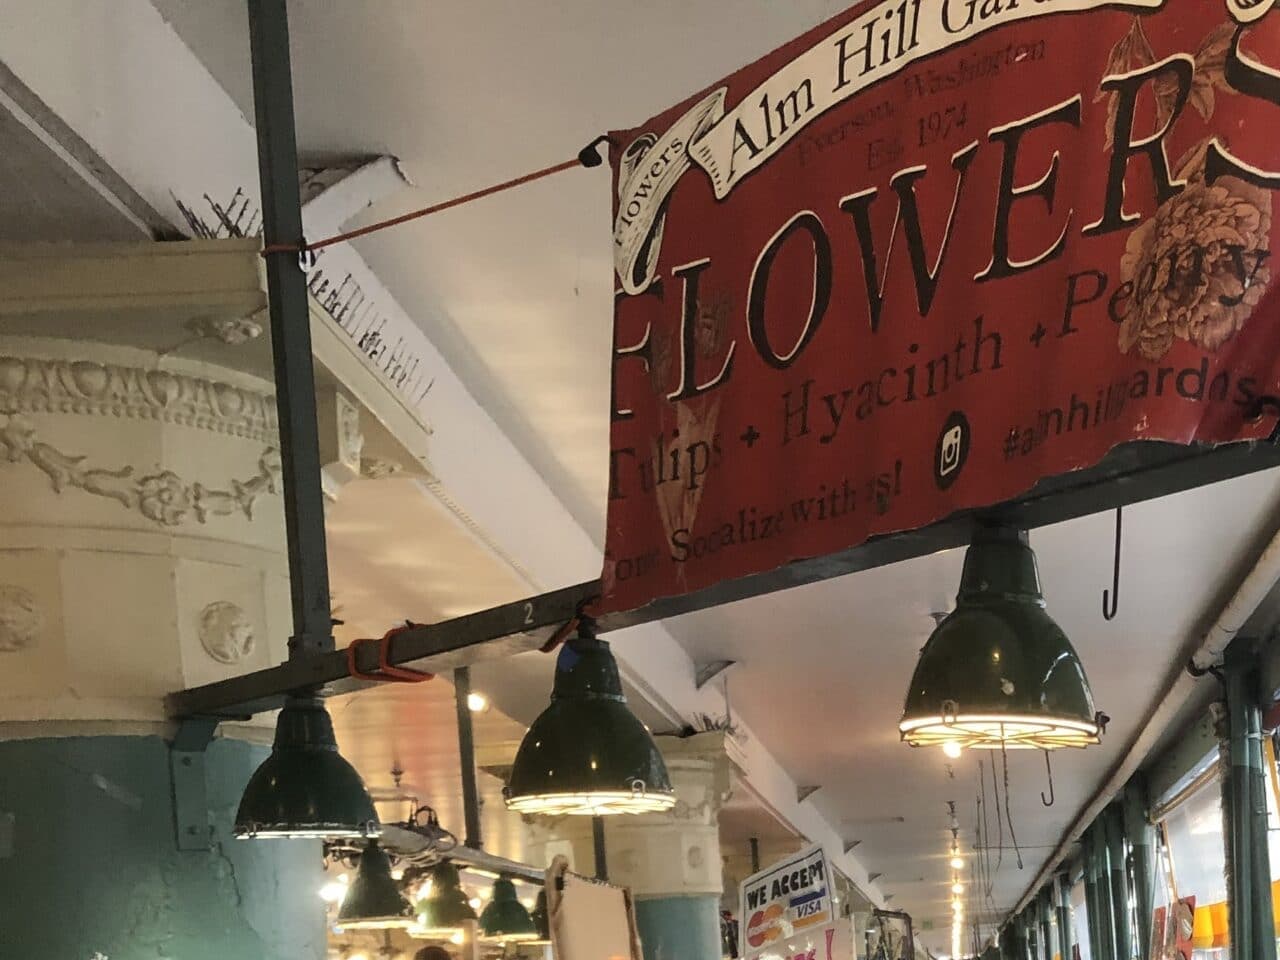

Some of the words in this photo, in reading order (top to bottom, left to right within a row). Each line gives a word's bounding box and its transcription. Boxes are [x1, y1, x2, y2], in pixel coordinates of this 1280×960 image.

[726, 77, 816, 184] Alm
[831, 0, 921, 94] Hill
[917, 102, 969, 147] 1974
[610, 426, 722, 500] Tulips
[780, 317, 1005, 447] Hyacinth
[789, 479, 858, 525] with
[524, 602, 534, 625] 2
[746, 885, 768, 911] WE
[770, 859, 825, 904] ACCEPT
[795, 898, 823, 919] VISA
